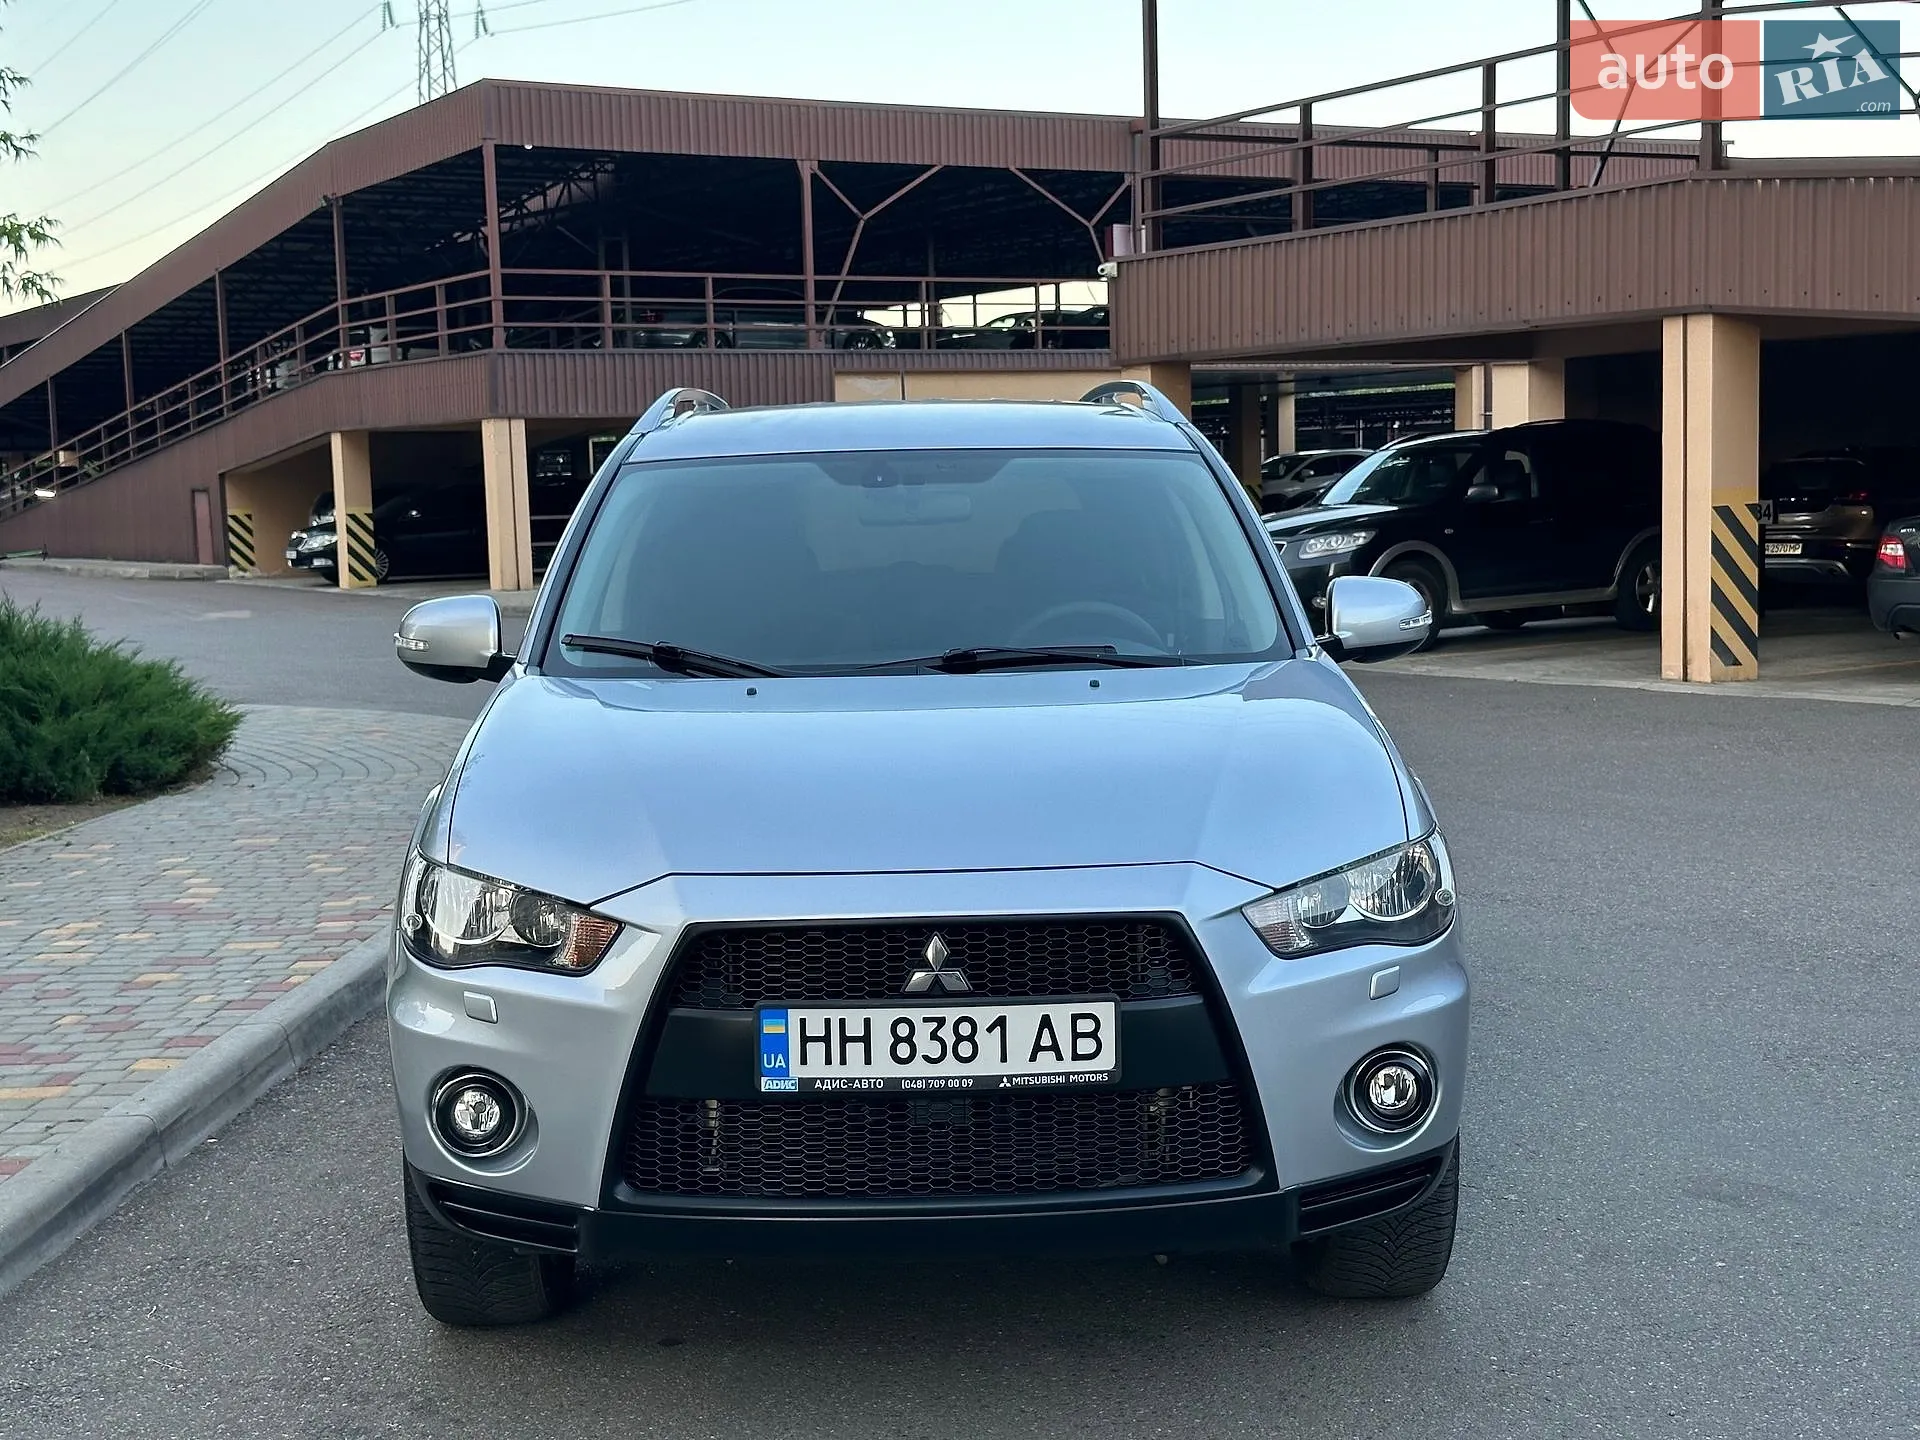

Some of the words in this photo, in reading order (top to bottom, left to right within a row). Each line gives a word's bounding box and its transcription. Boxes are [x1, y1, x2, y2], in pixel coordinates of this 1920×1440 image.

[799, 1017, 872, 1066] HH
[889, 1015, 1008, 1065] 8381
[1028, 1012, 1103, 1063] AB
[763, 1054, 787, 1069] UA
[814, 1079, 884, 1091] АДИС-АВТО
[901, 1079, 926, 1090] (048)
[928, 1079, 945, 1090] 709
[948, 1079, 961, 1089] 00
[961, 1078, 974, 1089] 09
[1012, 1075, 1066, 1086] MITSUBISHI
[1069, 1072, 1109, 1083] MOTORS
